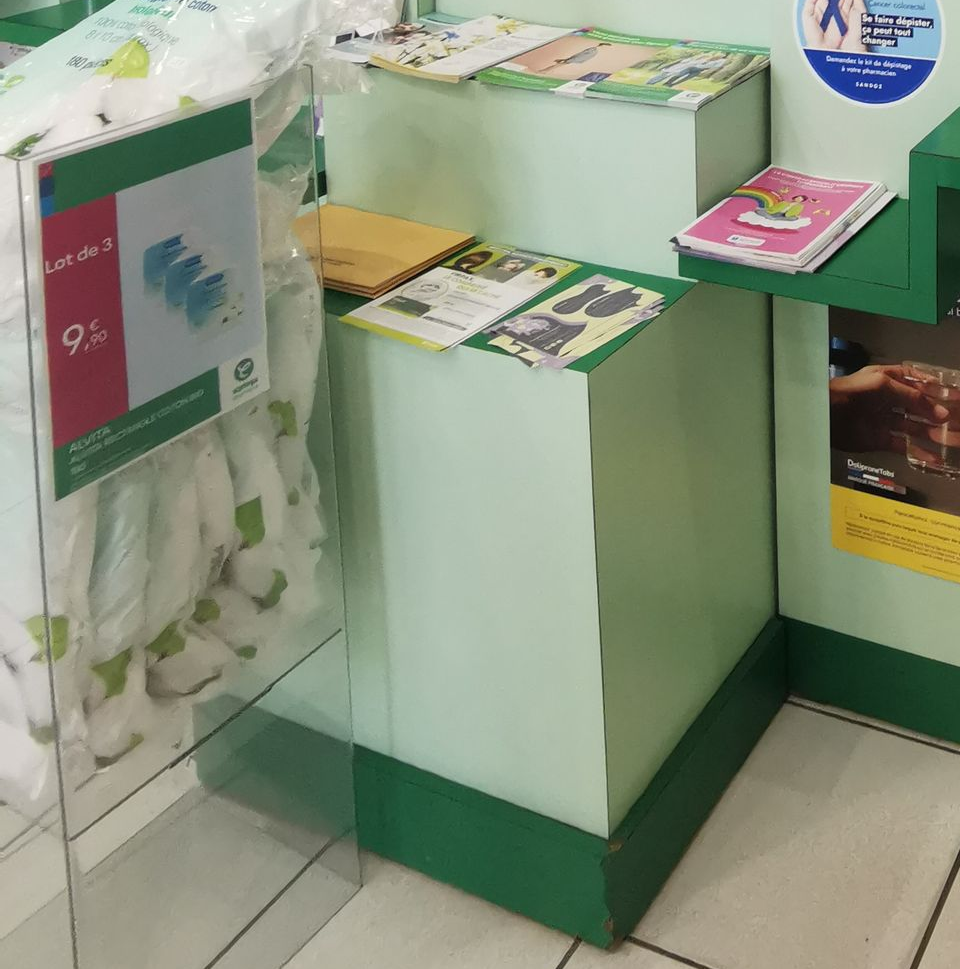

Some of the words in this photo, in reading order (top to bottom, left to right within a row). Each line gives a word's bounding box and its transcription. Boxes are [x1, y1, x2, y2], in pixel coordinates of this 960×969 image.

[188, 0, 218, 14] coton
[868, 0, 891, 8] Cancer
[862, 14, 873, 22] Se
[874, 14, 895, 25] faire
[896, 16, 933, 30] dépister,
[862, 26, 872, 35] ça
[873, 27, 893, 38] peut
[894, 27, 911, 36] tout
[862, 35, 896, 47] changer
[826, 55, 857, 65] Demandez
[857, 57, 863, 65] le
[864, 58, 873, 66] kit
[873, 59, 882, 67] de
[882, 59, 912, 71] dépistage
[841, 65, 846, 73] à
[847, 66, 862, 74] votre
[862, 67, 897, 77] pharmacien
[855, 81, 883, 90] SANDOZ
[45, 246, 74, 275] Lot
[77, 243, 99, 262] de
[102, 238, 114, 252] 3
[62, 324, 85, 356] 9
